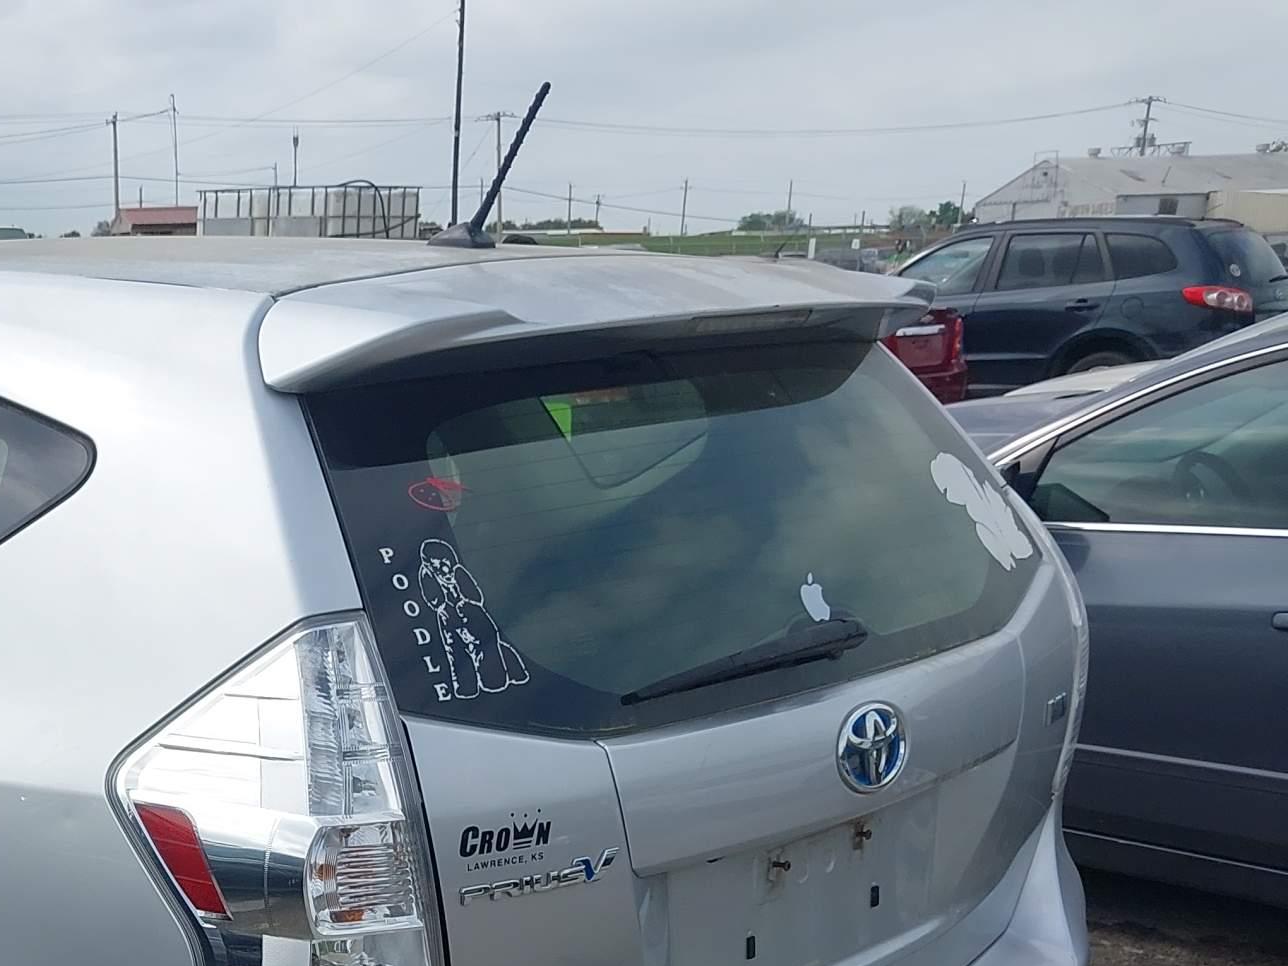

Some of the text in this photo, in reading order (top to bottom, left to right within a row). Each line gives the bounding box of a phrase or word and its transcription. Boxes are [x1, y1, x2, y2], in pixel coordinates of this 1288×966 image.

[379, 548, 452, 701] POODLE
[467, 851, 544, 872] LAWRENCE, KS
[459, 865, 586, 906] PRIUS
